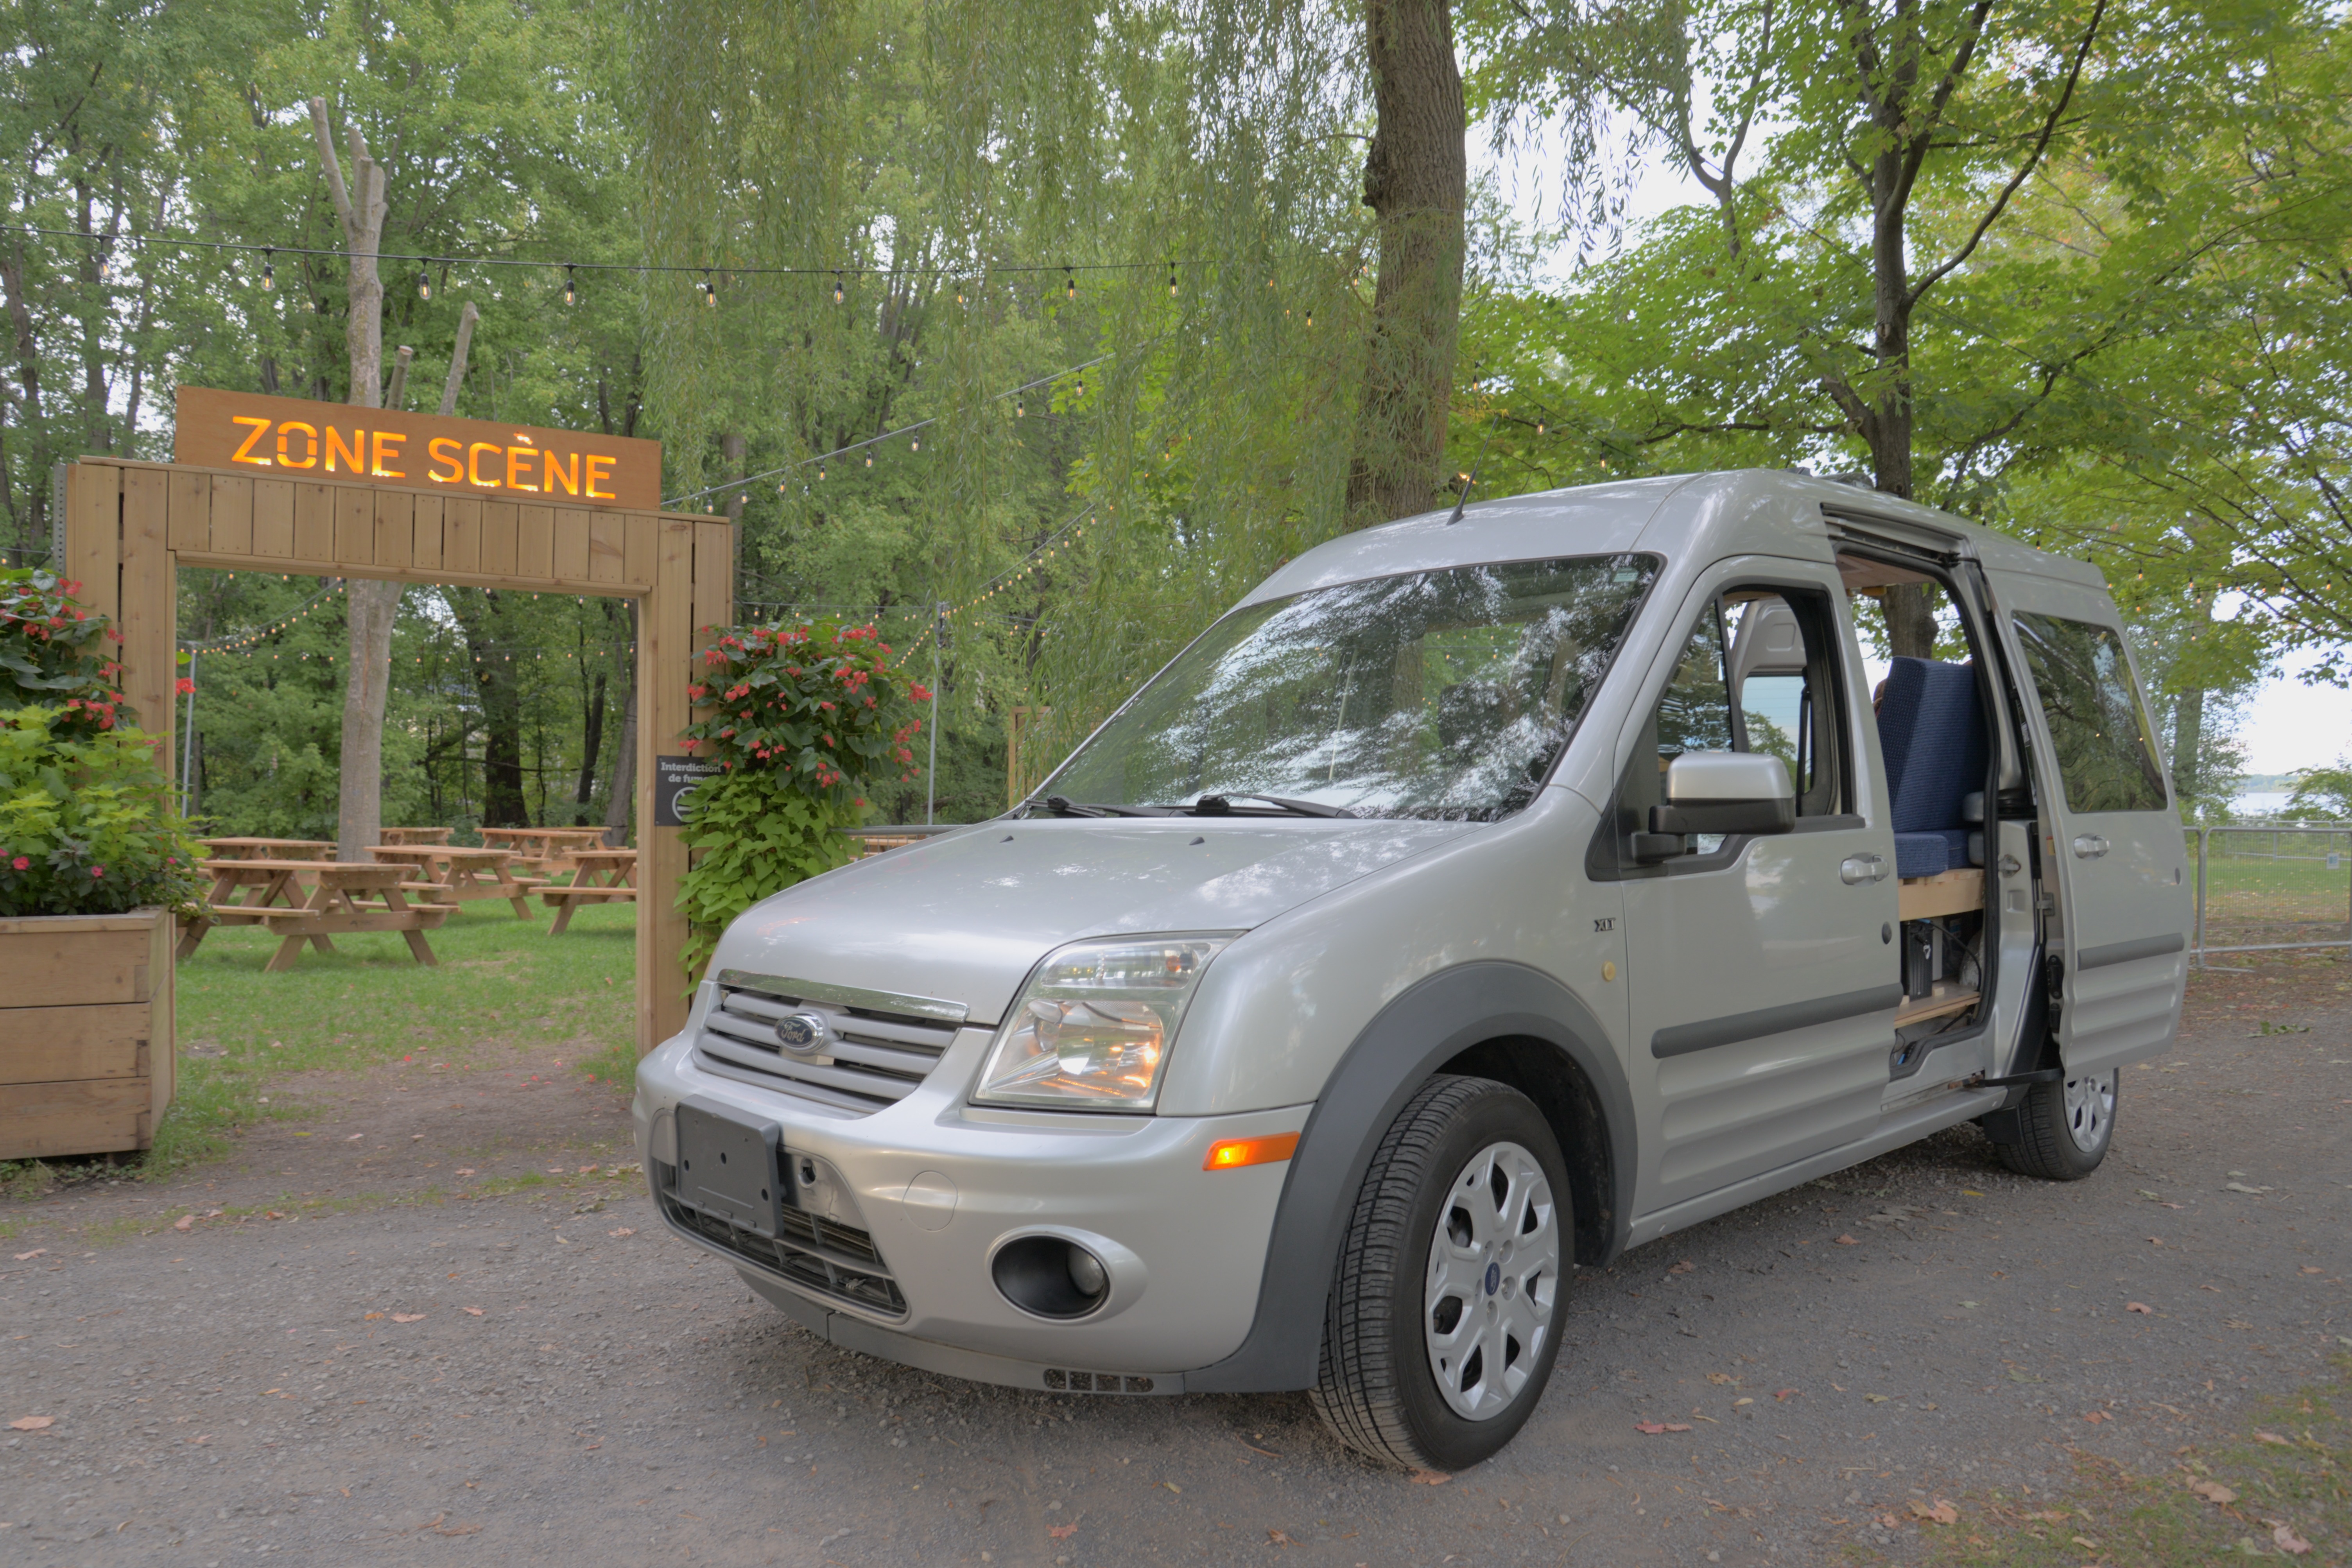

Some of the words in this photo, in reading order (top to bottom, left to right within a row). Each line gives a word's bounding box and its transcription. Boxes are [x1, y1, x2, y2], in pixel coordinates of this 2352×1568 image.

[231, 416, 407, 478] ZONE
[427, 432, 617, 500] SCÈNE
[661, 762, 721, 772] Interdiction
[668, 774, 681, 782] de
[1594, 917, 1616, 932] XLT
[782, 1021, 808, 1043] Ford
